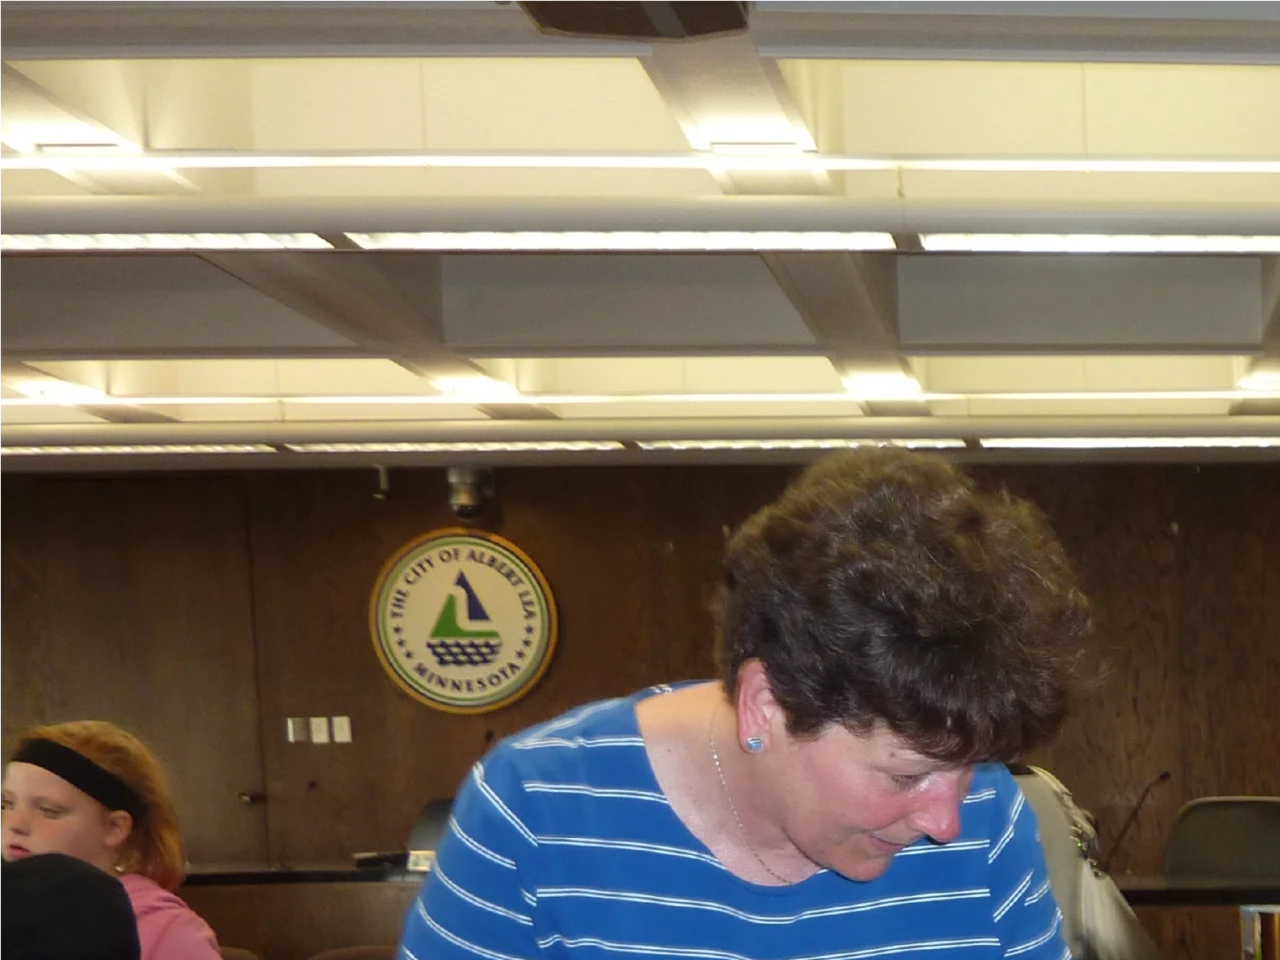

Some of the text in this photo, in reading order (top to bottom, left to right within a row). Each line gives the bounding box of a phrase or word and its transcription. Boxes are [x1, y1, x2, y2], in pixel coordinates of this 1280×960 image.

[391, 549, 537, 620] THE CITY OF ALBERT LEA
[413, 661, 521, 693] MINNESOTA
